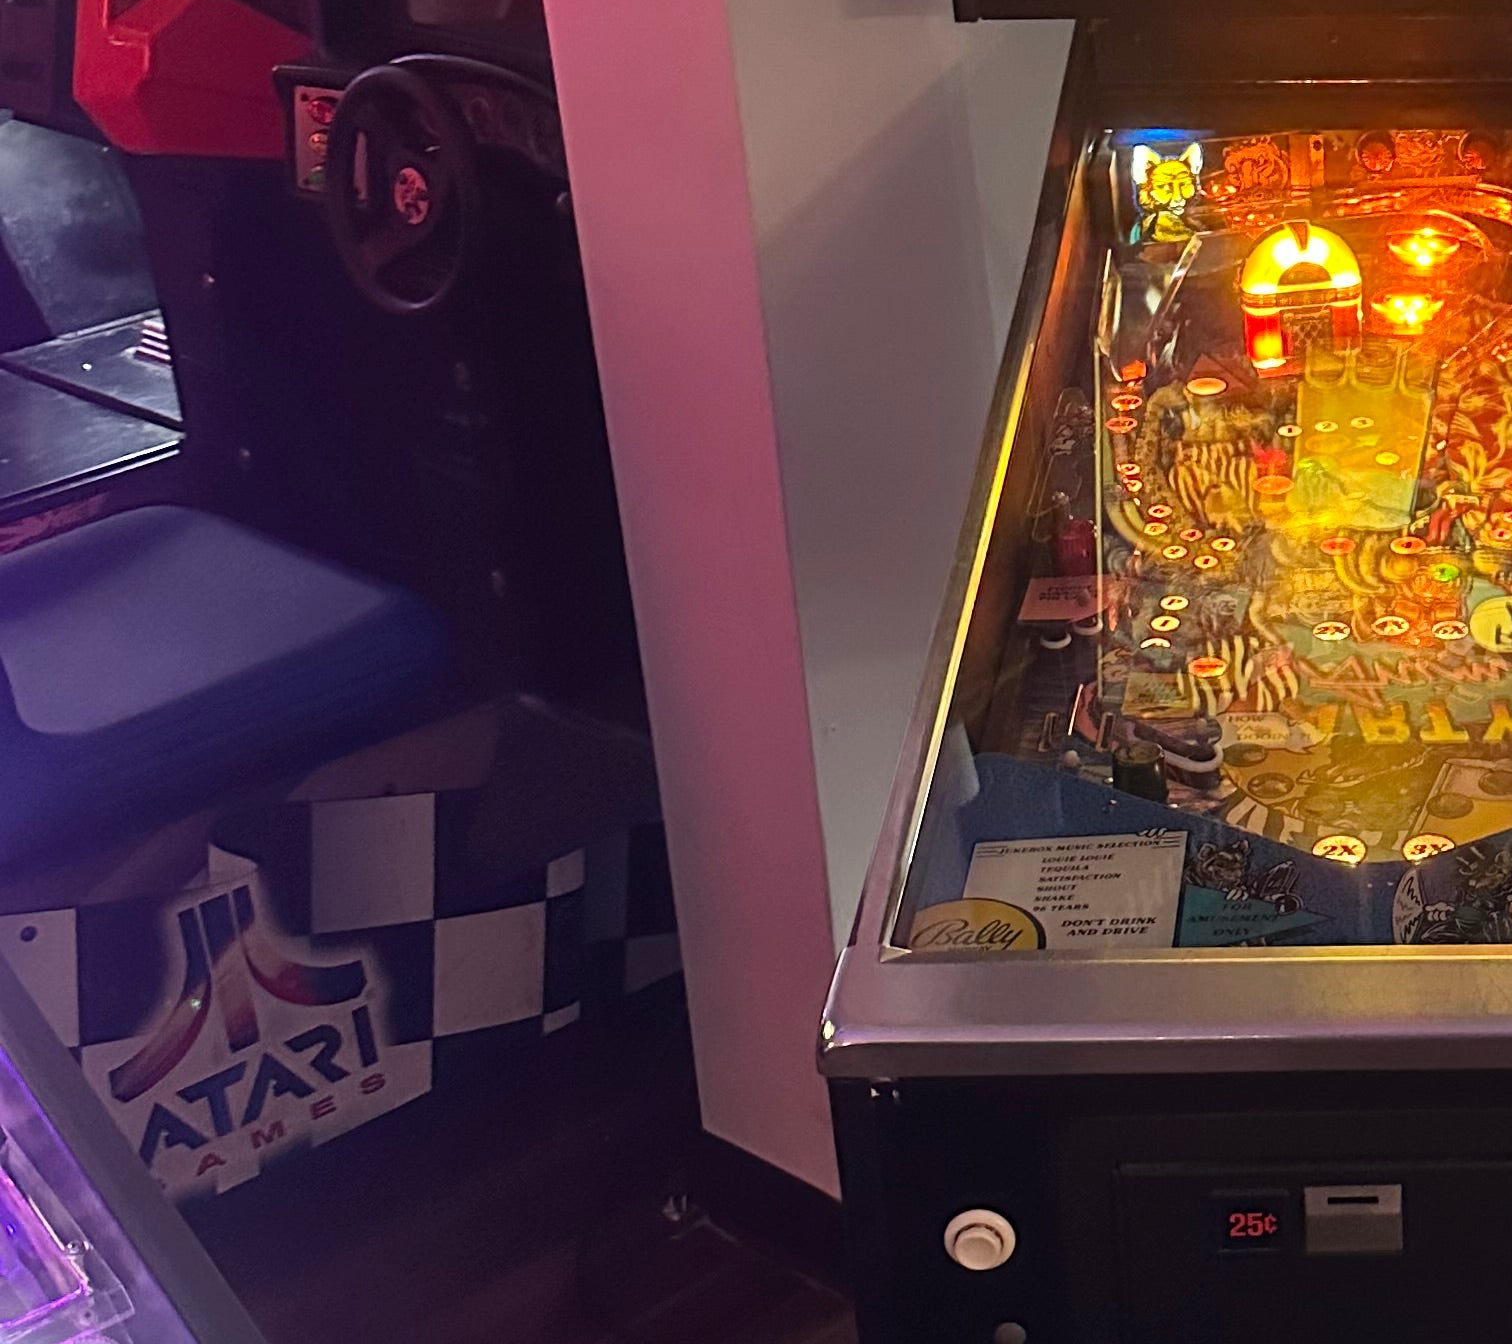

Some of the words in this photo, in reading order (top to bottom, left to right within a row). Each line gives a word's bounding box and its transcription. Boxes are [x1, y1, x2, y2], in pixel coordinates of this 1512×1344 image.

[997, 844, 1053, 855] JUKEBOX
[1056, 842, 1094, 853] MUSIC
[1096, 839, 1161, 850] SELECTION
[1322, 843, 1358, 857] 2X
[1040, 864, 1089, 874] TEQUILA
[1038, 872, 1122, 883] SATISFACTION
[1036, 883, 1078, 893] SHOUT
[1034, 893, 1075, 902] SHAKE
[1051, 903, 1090, 912] TEARS
[1061, 917, 1105, 928] DON'T
[1108, 916, 1158, 926] DRINK
[1187, 914, 1278, 924] AMUSEMENT
[910, 918, 1024, 949] Bally
[1066, 927, 1098, 937] AND
[1101, 926, 1150, 936] DRIVE
[139, 1004, 379, 1166] ATARI
[195, 1071, 386, 1177] AMES
[1229, 1212, 1278, 1238] 25¢
